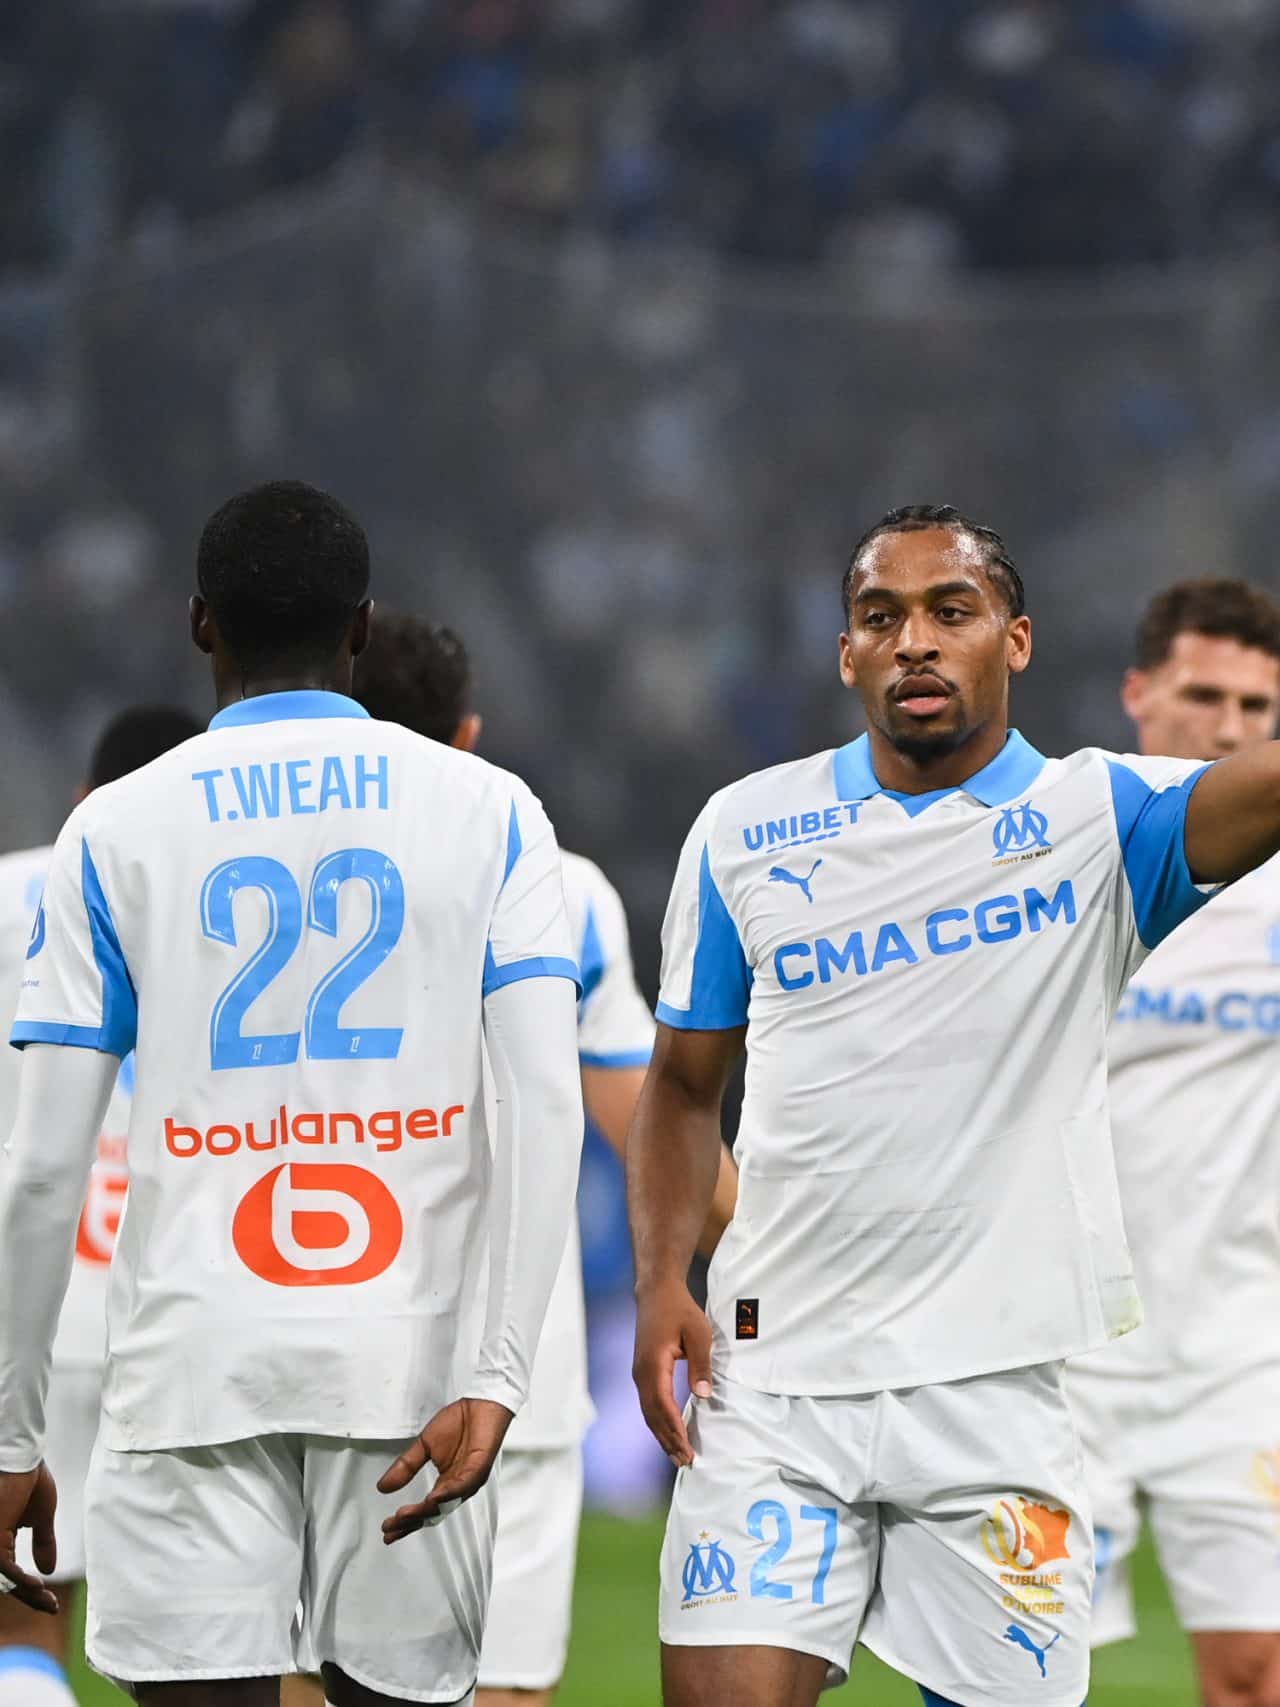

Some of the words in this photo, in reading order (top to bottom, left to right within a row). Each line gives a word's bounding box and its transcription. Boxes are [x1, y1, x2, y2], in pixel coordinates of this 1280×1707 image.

[191, 754, 390, 823] T.WEAH
[743, 802, 864, 851] UNIBET
[199, 847, 406, 1072] 22
[773, 920, 919, 992] CMA
[924, 879, 1078, 957] CGM
[164, 1104, 465, 1158] boulanger
[746, 1499, 838, 1605] 27
[1000, 1573, 1063, 1586] SUBLIME
